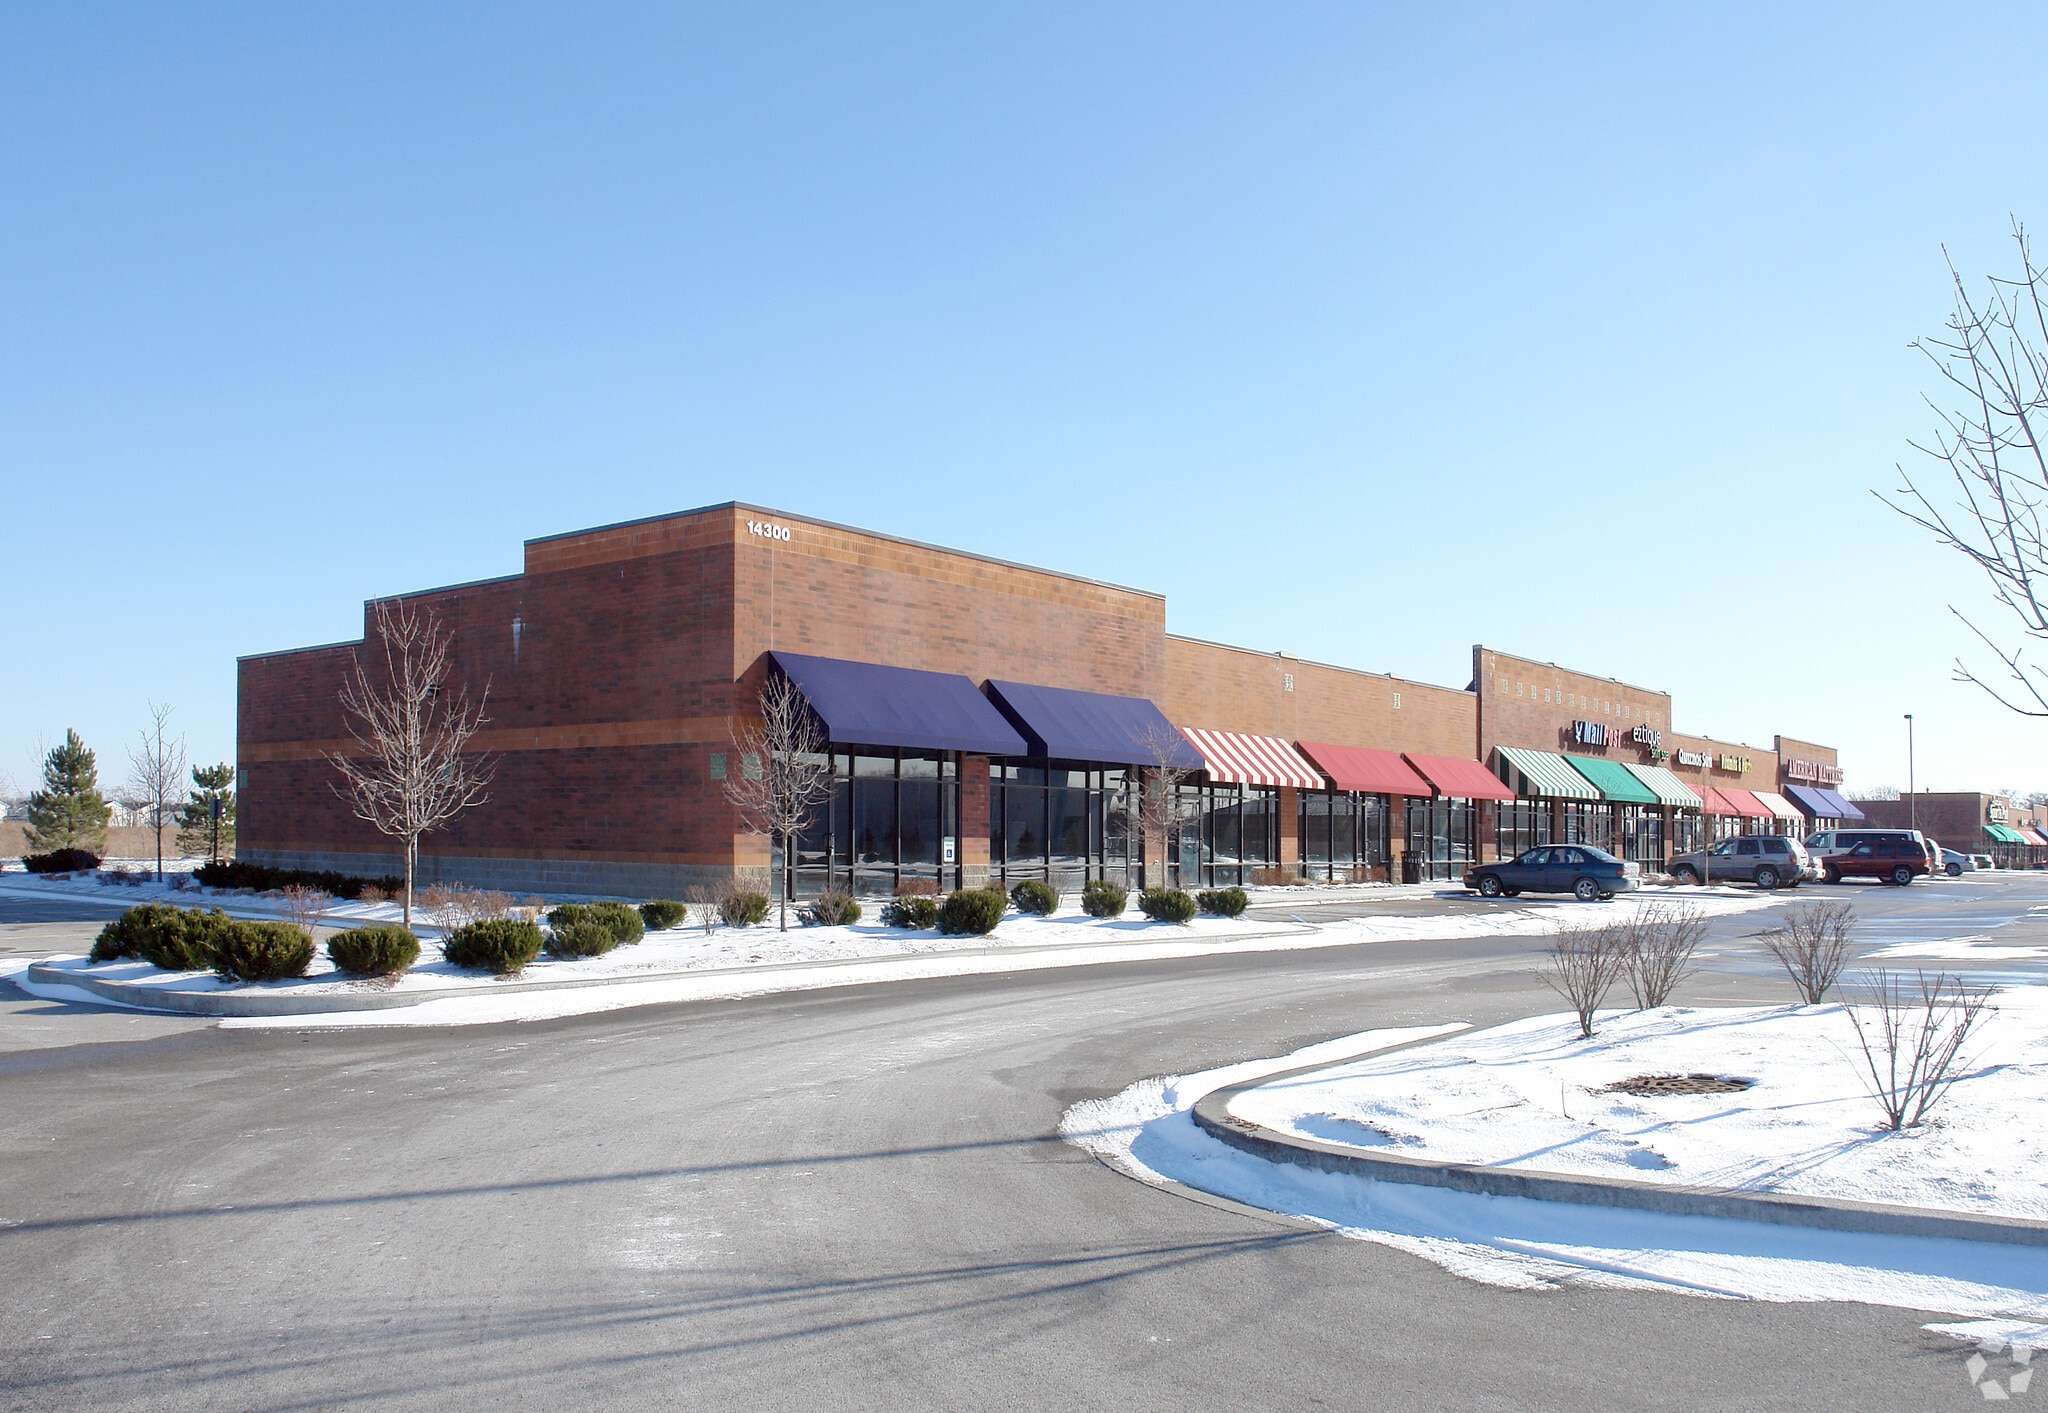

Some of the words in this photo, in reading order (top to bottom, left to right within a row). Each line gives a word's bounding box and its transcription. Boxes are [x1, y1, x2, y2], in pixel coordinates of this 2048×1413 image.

[747, 520, 791, 542] 14300
[1583, 721, 1603, 746] Mail
[1603, 724, 1622, 748] Post
[1633, 723, 1662, 749] eztique
[1788, 758, 1818, 782] AMERICAN
[1818, 763, 1844, 785] MATTRESS
